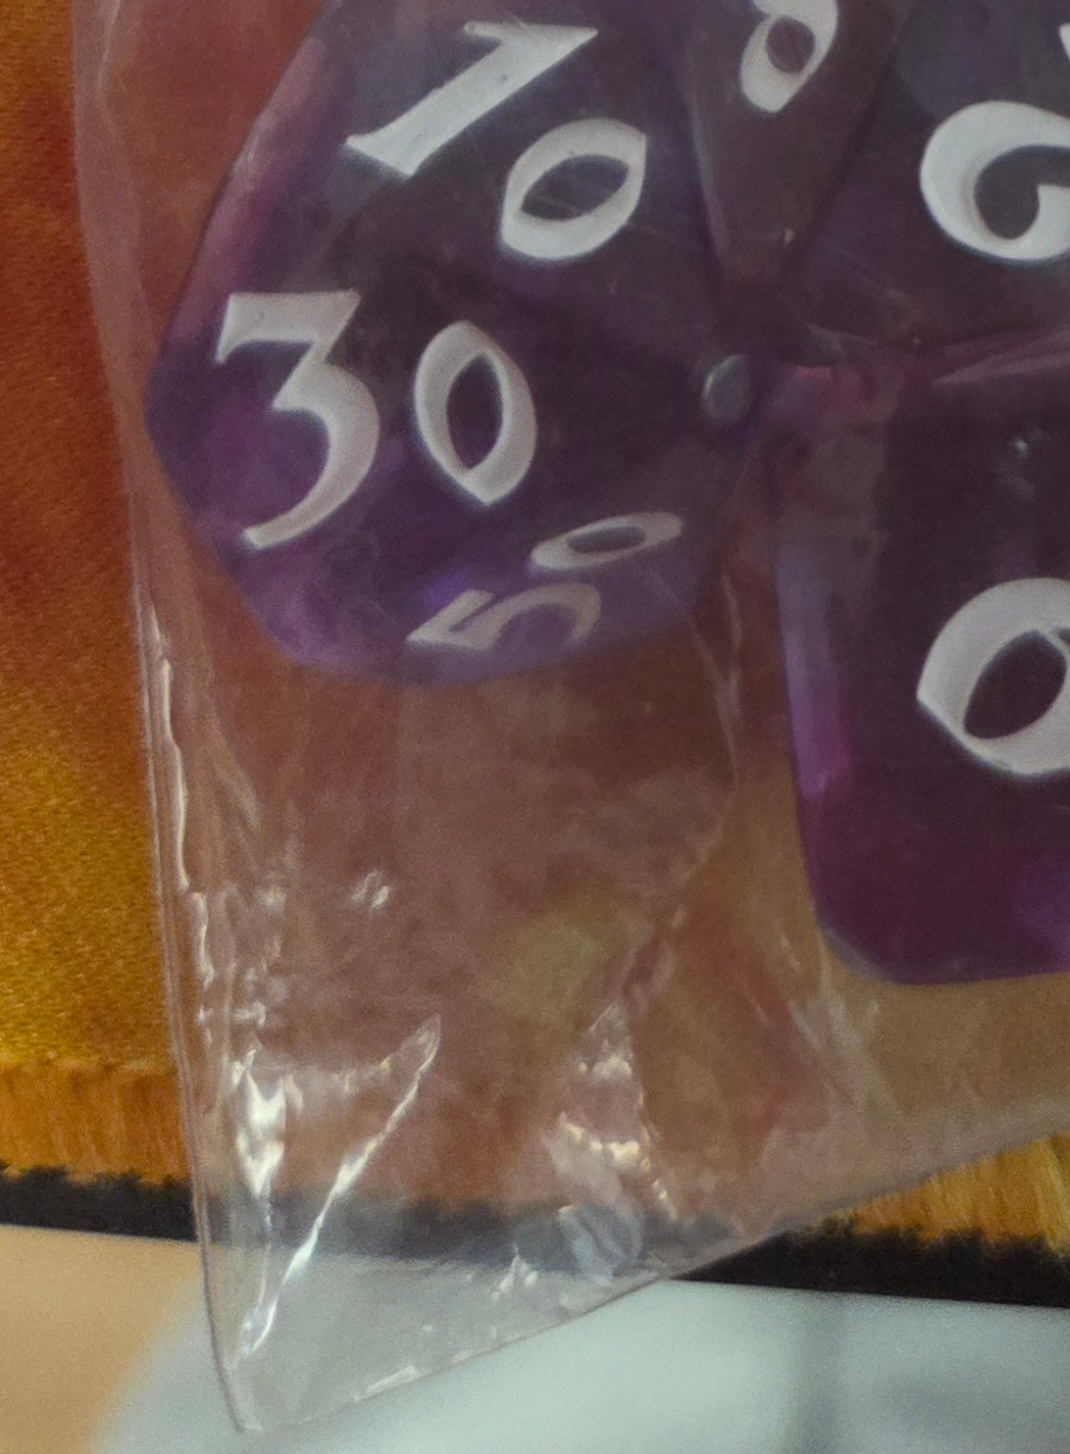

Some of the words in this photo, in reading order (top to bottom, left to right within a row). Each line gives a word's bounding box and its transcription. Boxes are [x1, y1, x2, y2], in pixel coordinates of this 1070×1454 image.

[343, 19, 648, 262] 10
[214, 288, 538, 551] 30
[405, 510, 684, 651] 50
